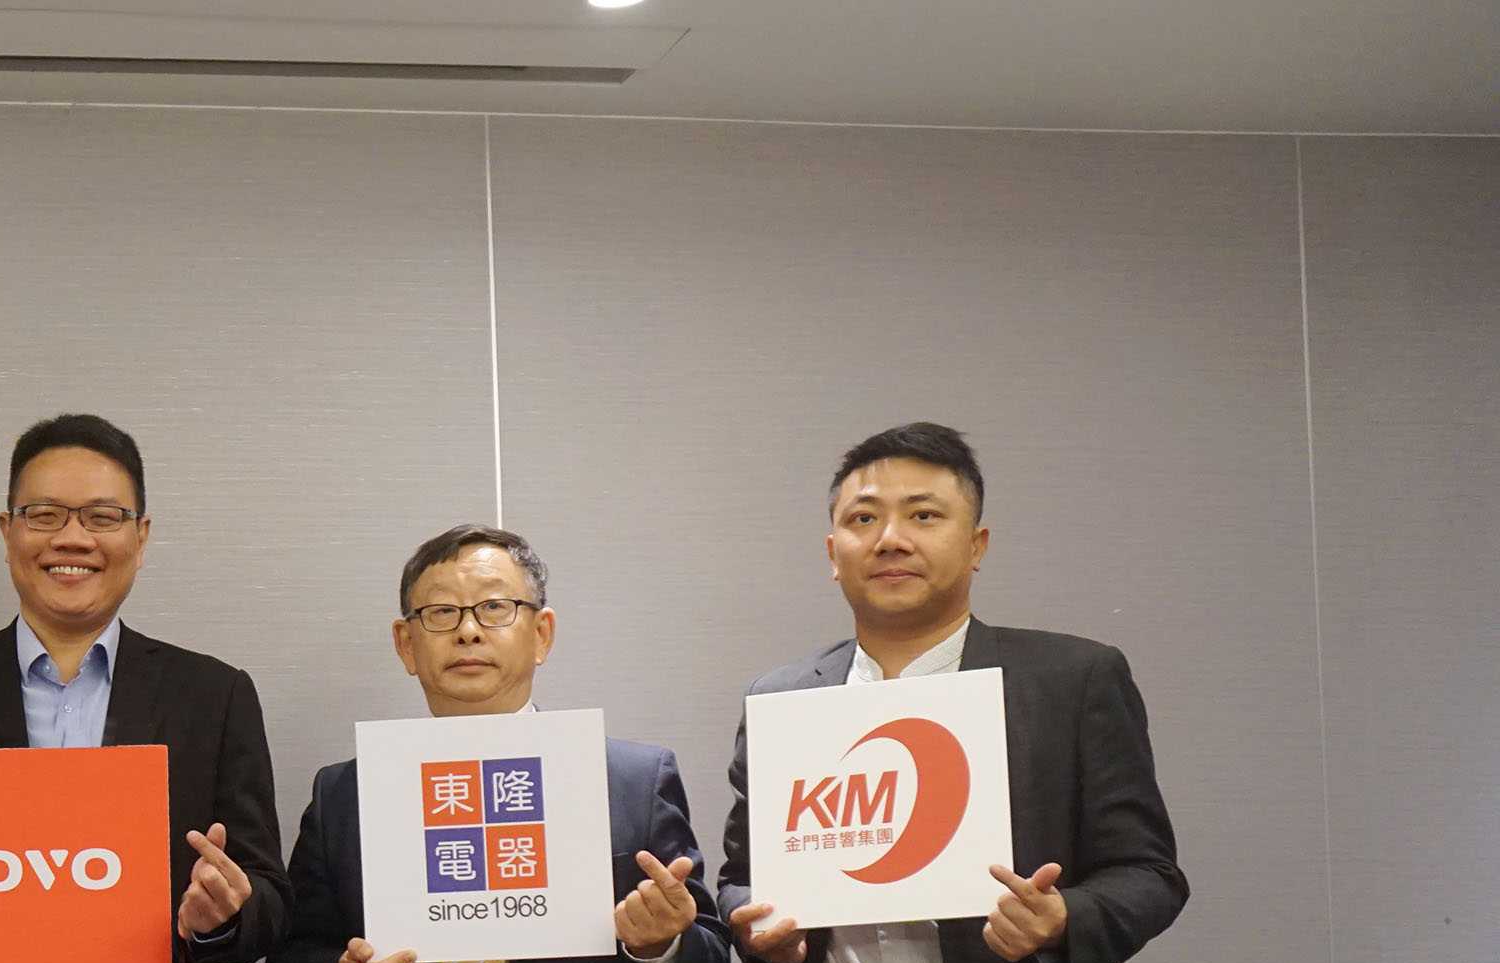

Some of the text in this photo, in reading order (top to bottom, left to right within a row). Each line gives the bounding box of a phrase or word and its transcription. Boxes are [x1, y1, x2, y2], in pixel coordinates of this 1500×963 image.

[430, 769, 535, 816] 東隆
[784, 827, 894, 853] 金門音響集團
[435, 836, 538, 881] 電器
[428, 894, 548, 922] since1968
